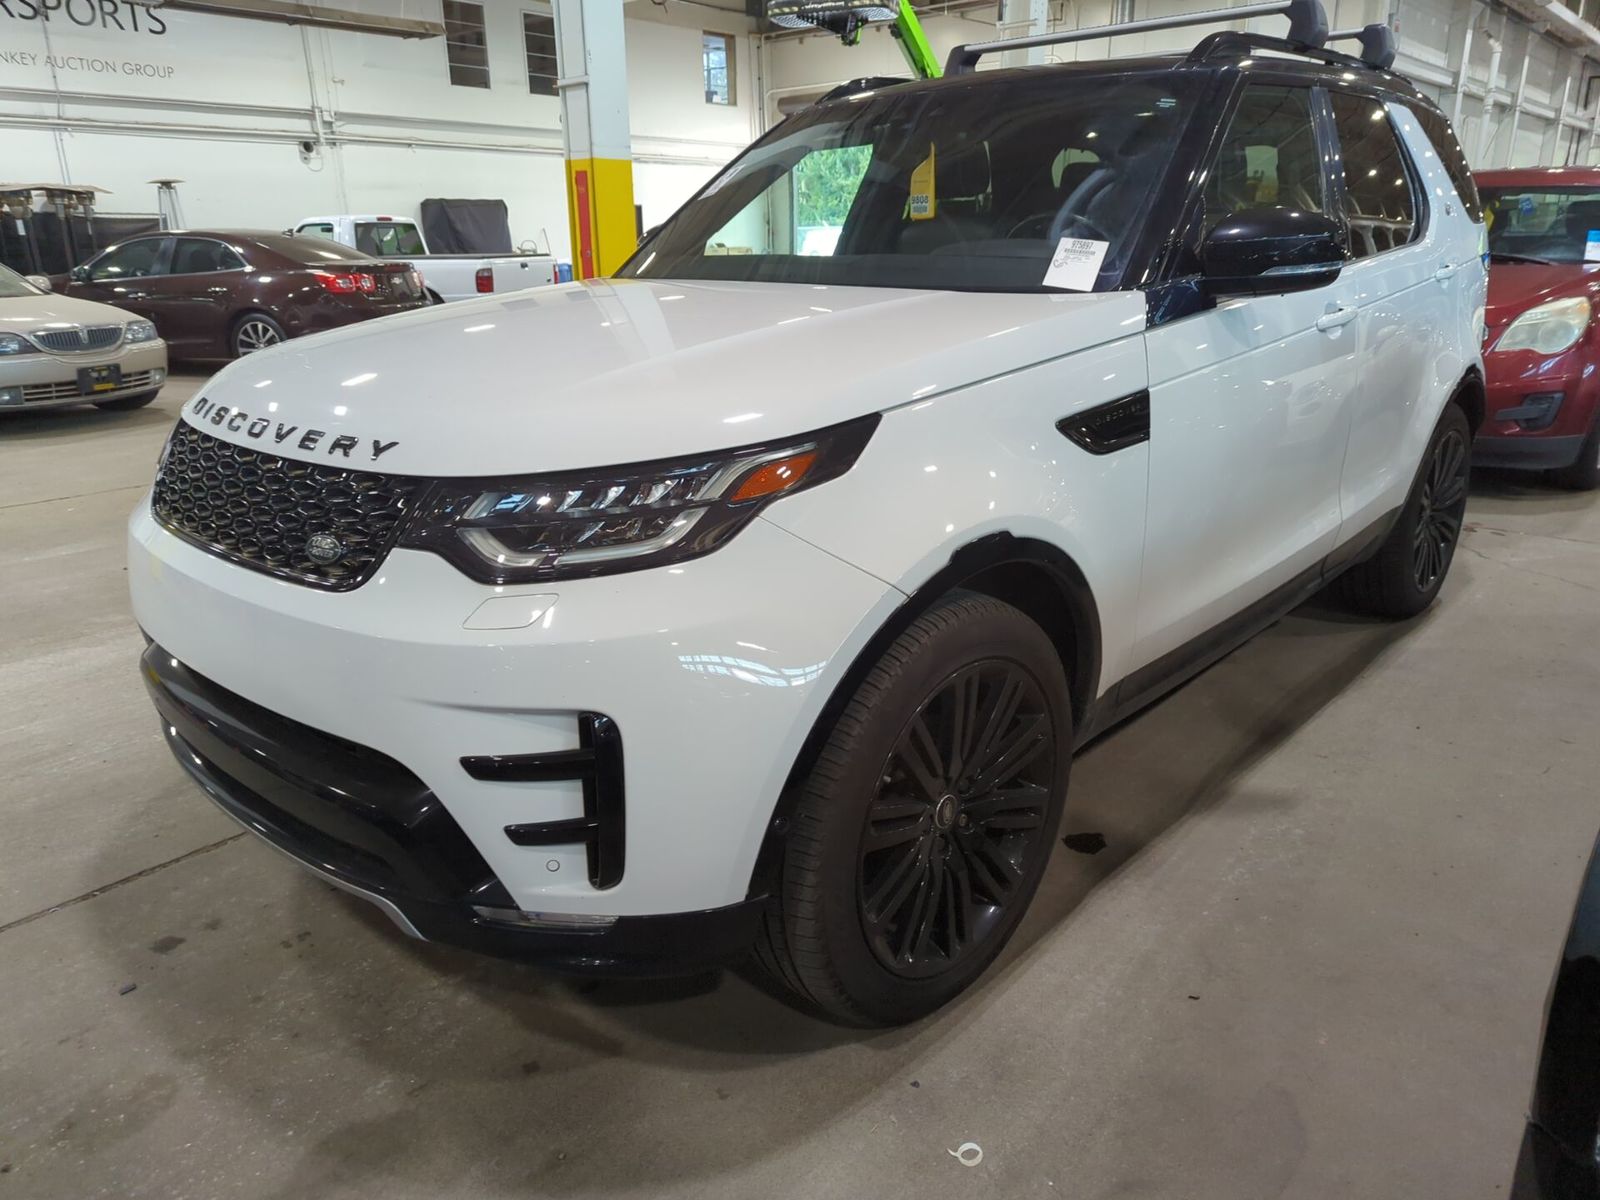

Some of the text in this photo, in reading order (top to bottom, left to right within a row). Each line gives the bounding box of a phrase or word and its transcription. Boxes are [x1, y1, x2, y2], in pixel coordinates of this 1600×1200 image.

[45, 55, 117, 73] AUCTION
[122, 62, 174, 78] GROUP
[192, 397, 400, 461] DISCOVERY
